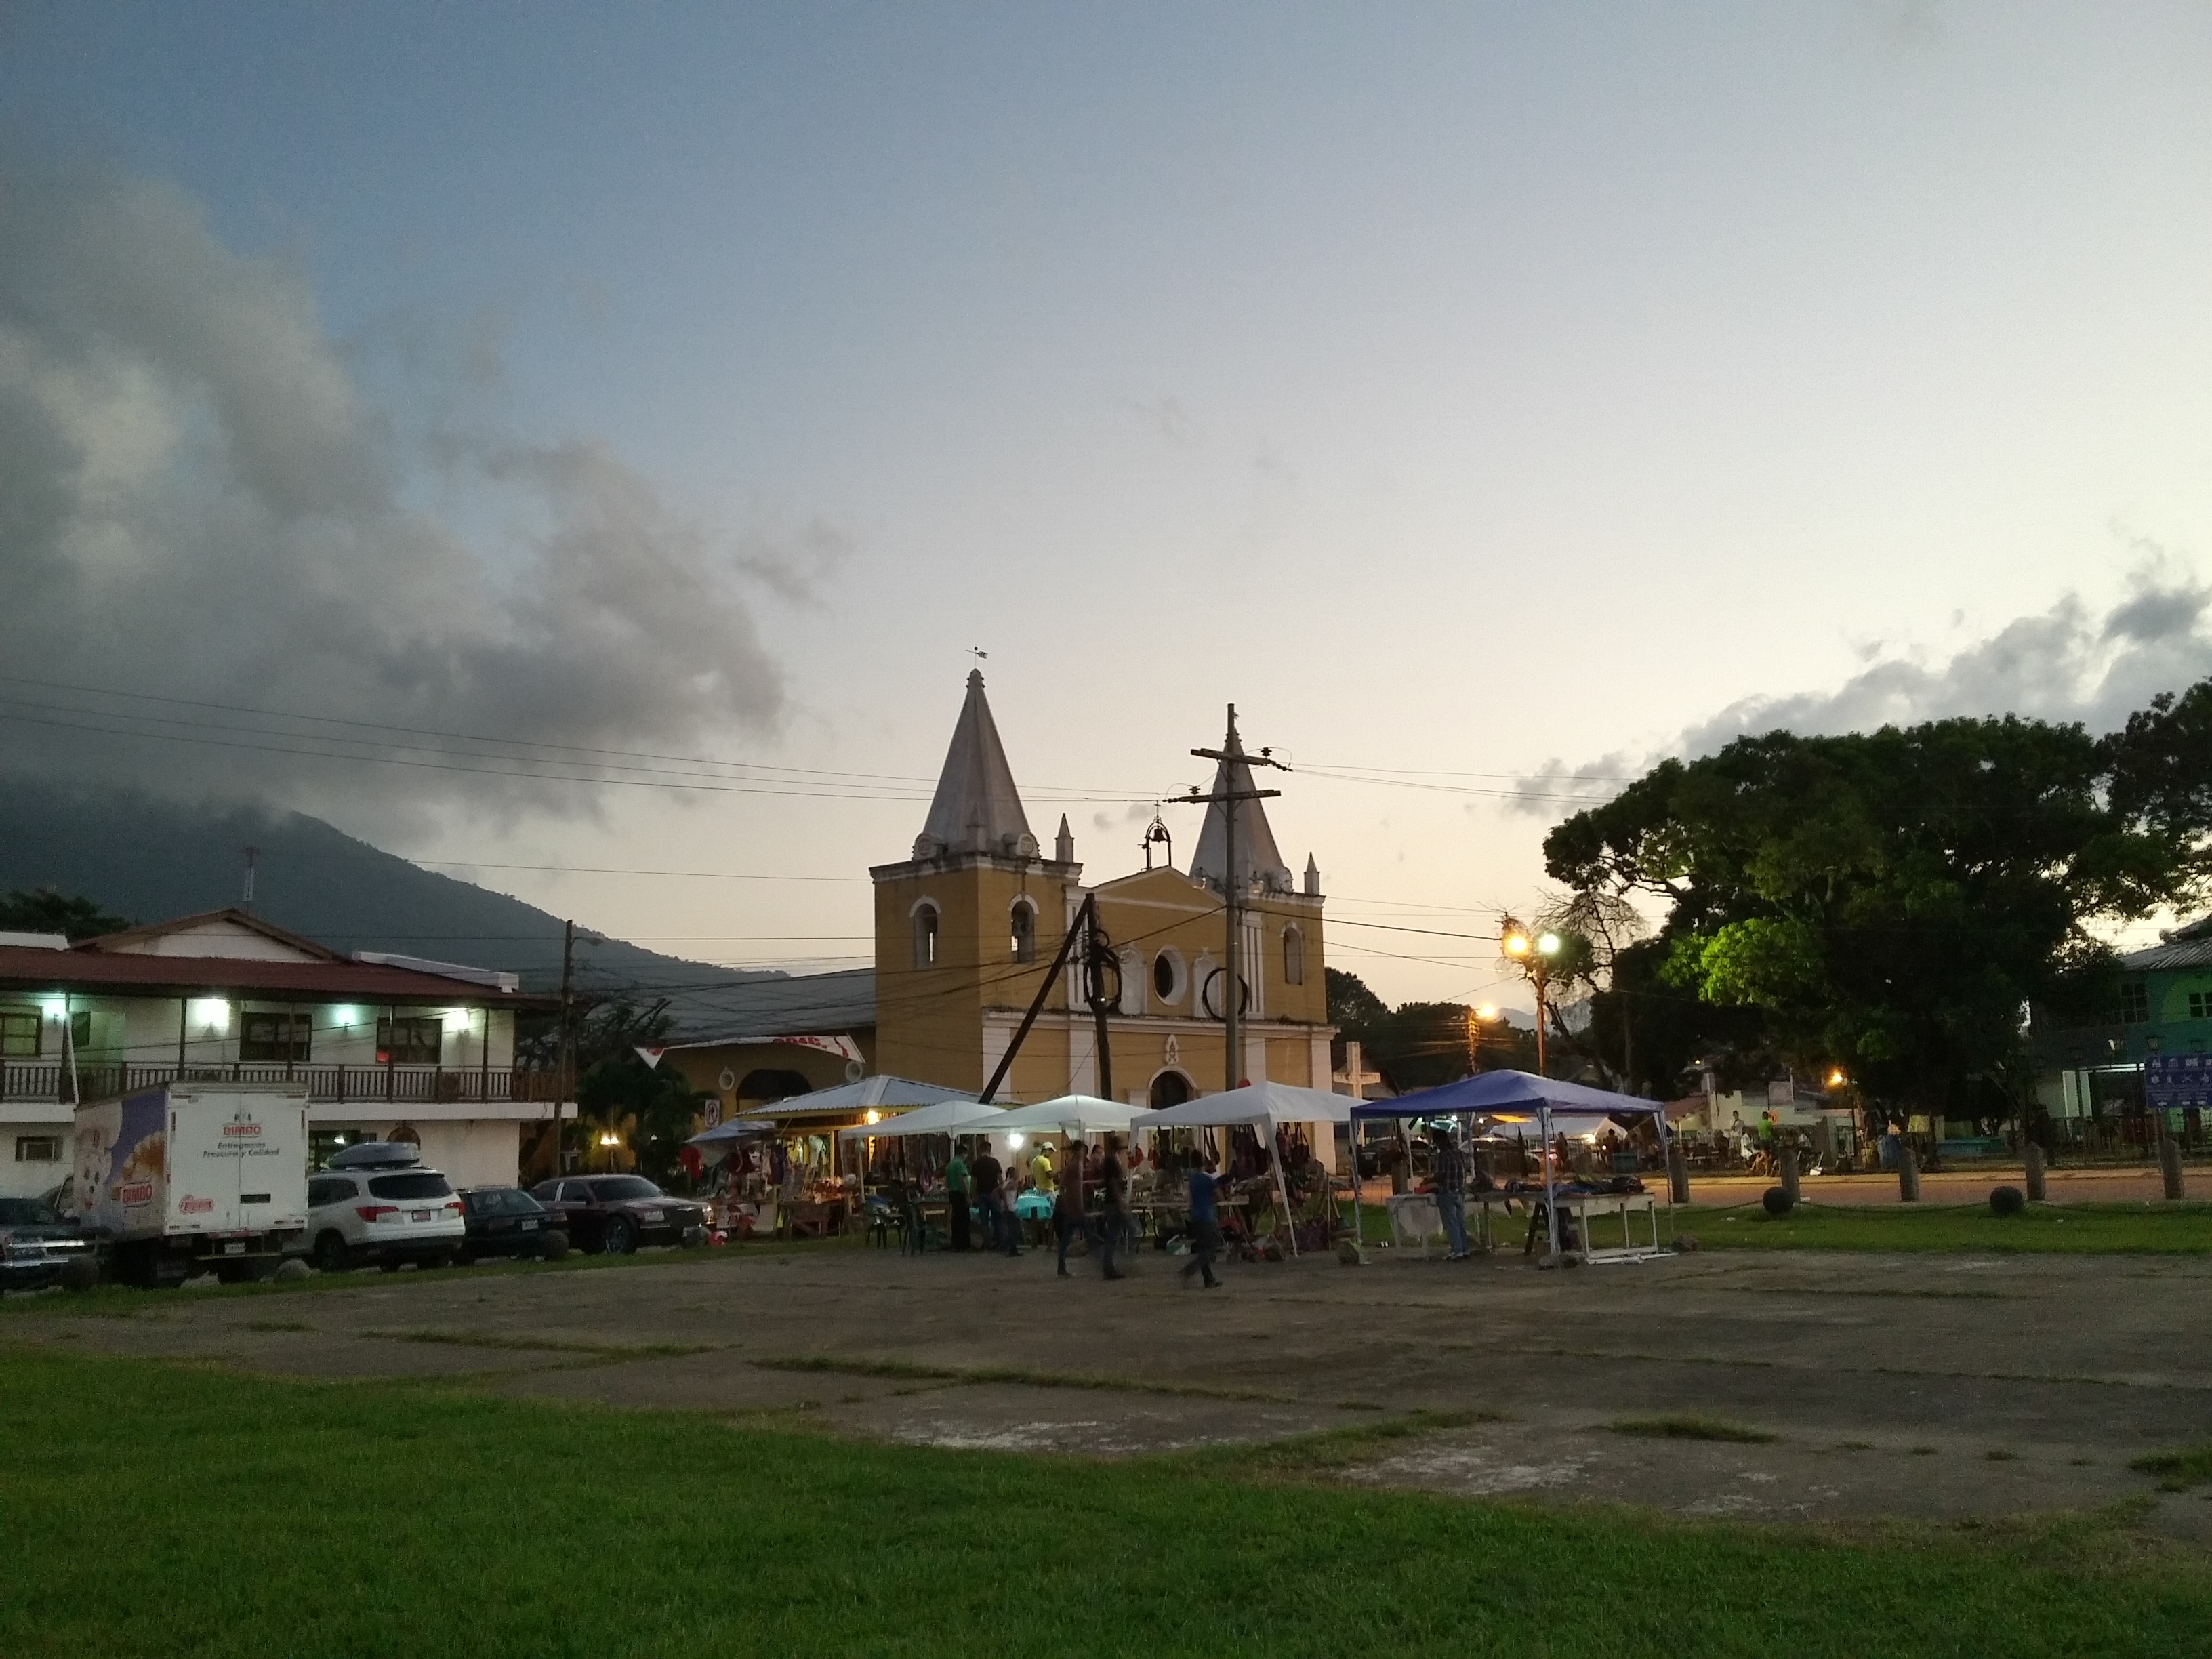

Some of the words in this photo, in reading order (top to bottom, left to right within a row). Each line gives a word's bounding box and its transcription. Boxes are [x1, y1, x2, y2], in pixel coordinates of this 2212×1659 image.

[222, 1126, 262, 1136] BIMBO
[248, 1147, 279, 1156] Calidad
[122, 1184, 153, 1205] BIMBO
